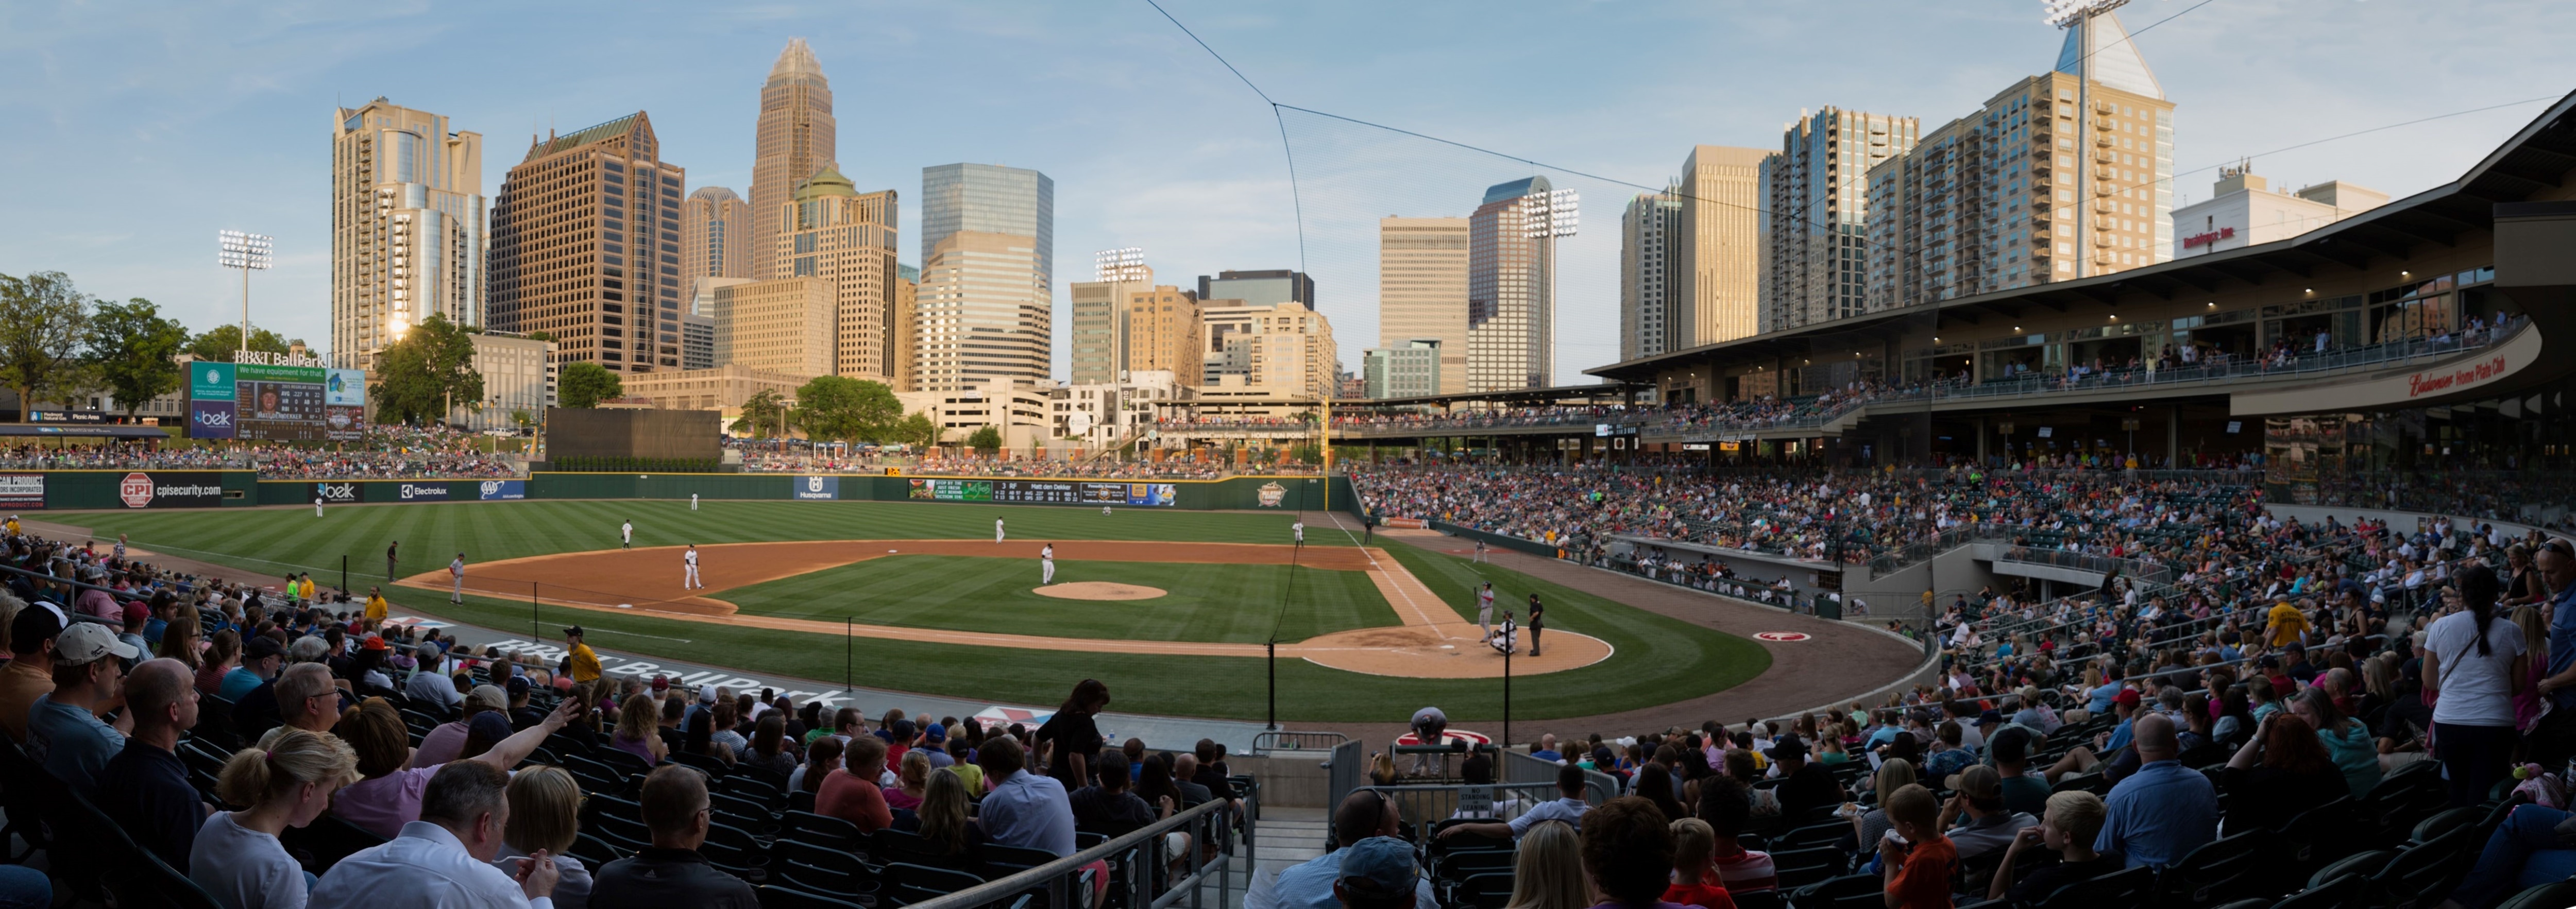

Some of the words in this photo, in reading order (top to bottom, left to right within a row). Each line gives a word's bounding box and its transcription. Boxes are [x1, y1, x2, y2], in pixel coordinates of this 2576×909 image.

[2183, 232, 2218, 249] Residence
[2221, 227, 2233, 239] Inn
[234, 350, 271, 365] BB&T
[274, 352, 326, 368] BallPark
[267, 368, 299, 376] equipment
[2409, 372, 2453, 397] Budweiser
[2456, 370, 2474, 386] Home
[2476, 362, 2491, 381] Plate
[2492, 354, 2505, 375] Club
[202, 410, 231, 426] belk
[13, 476, 44, 485] PRODUCT
[123, 485, 150, 495] CPI
[157, 484, 221, 498] cpisecurity.com
[326, 483, 355, 498] belk
